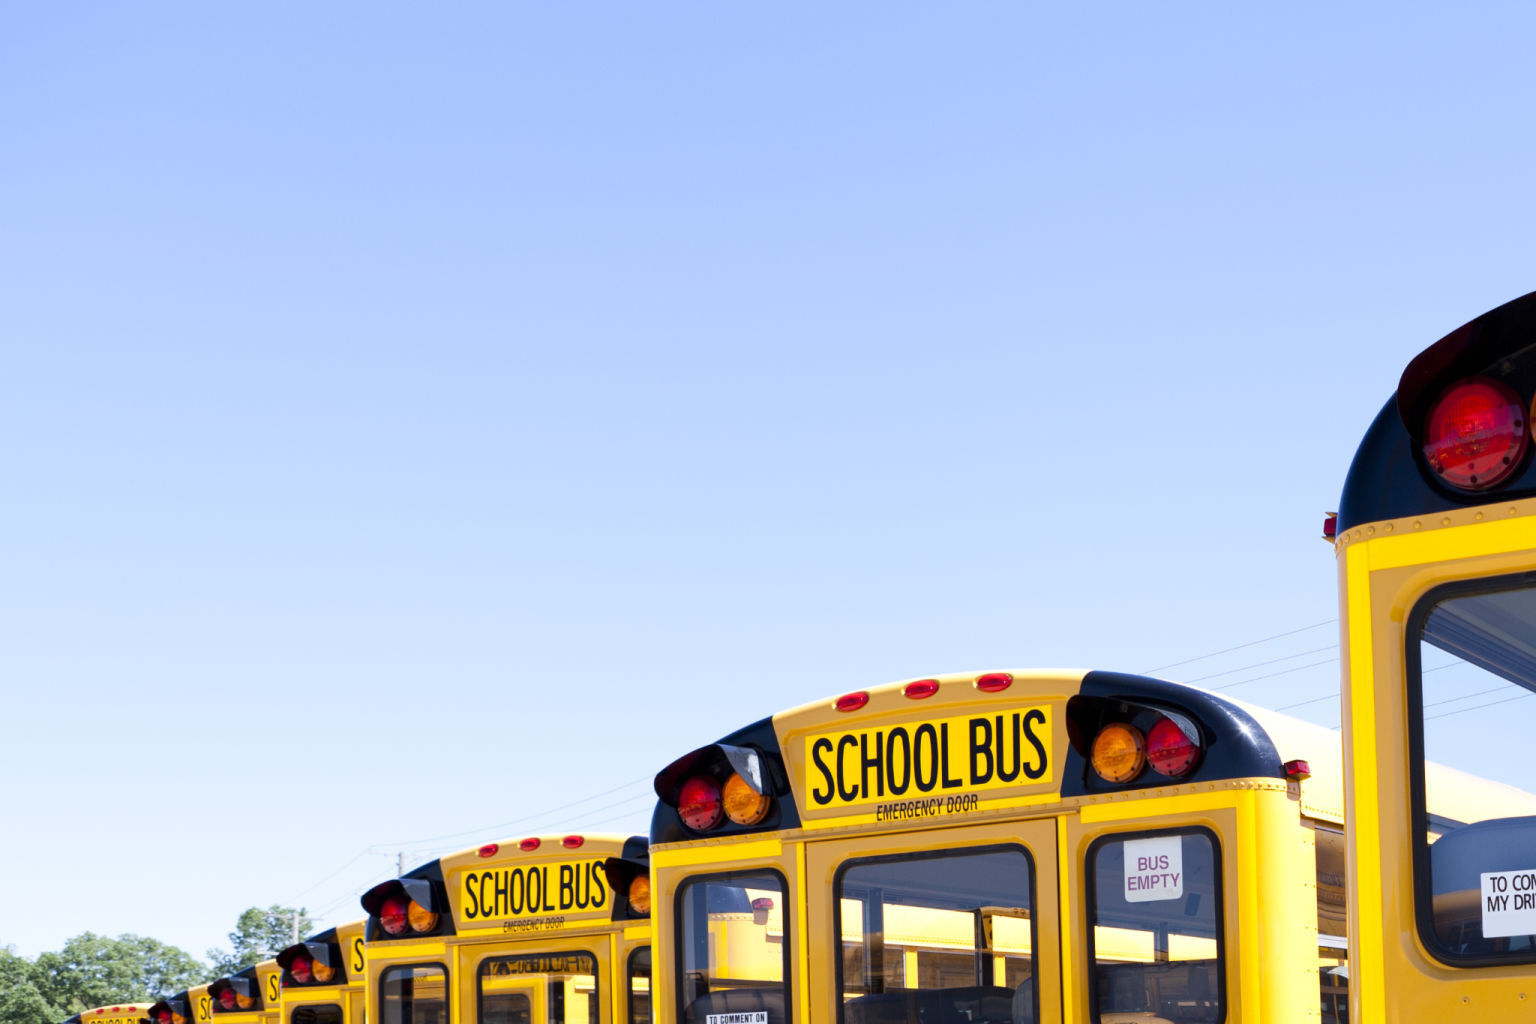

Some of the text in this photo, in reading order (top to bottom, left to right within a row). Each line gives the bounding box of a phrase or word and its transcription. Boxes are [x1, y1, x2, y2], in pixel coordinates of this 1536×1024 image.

[812, 708, 1049, 805] SCHOOL BUS
[876, 793, 978, 821] EMERGENCY DOOR
[1137, 854, 1169, 872] BUS
[465, 860, 606, 919] SCHOOL BUS
[1127, 872, 1180, 891] EMPTY
[1489, 876, 1508, 894] TO
[1487, 895, 1510, 912] MY
[503, 916, 565, 933] EMERGENCY DOOR
[708, 1013, 765, 1024] TO COMMENT ON
